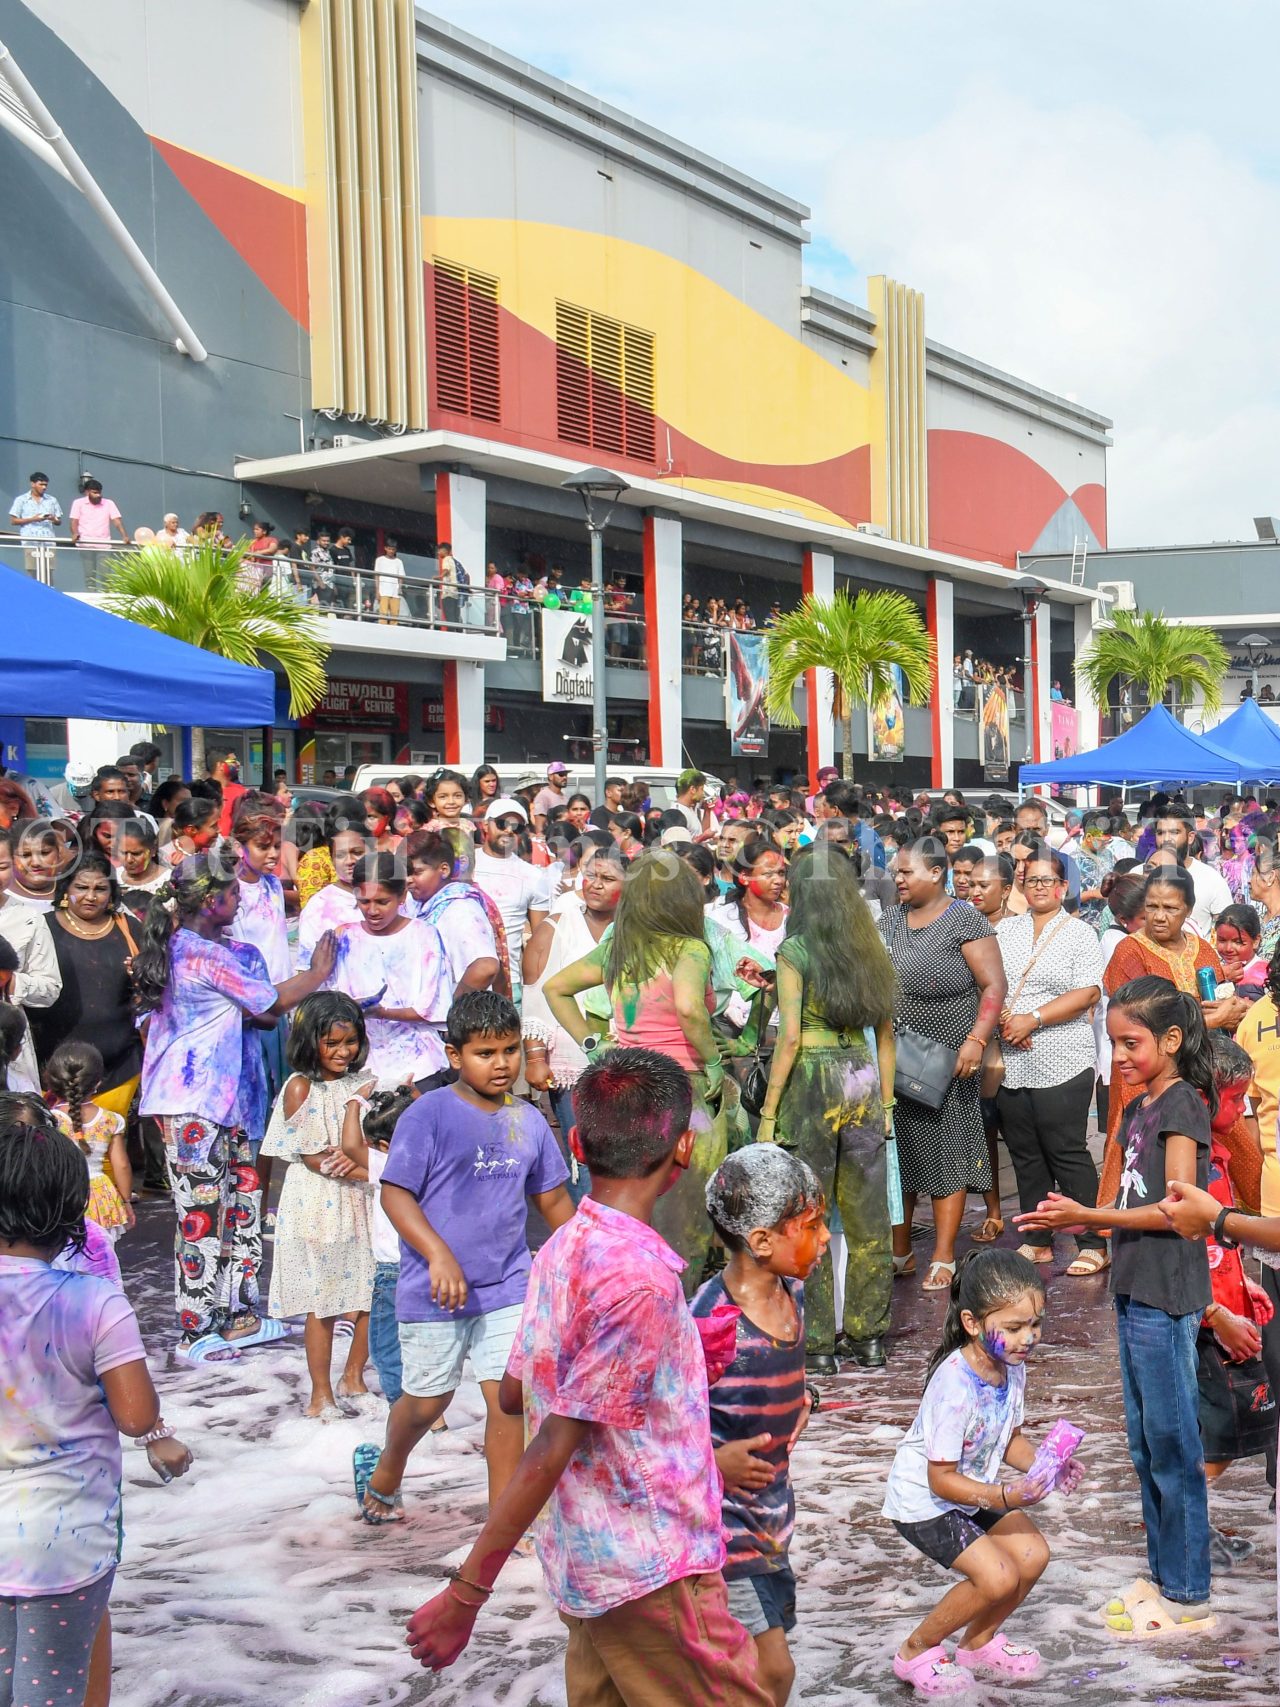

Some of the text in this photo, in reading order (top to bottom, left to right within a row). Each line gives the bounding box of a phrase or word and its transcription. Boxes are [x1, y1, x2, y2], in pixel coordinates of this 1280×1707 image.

[552, 671, 594, 702] Dogfath
[321, 697, 395, 714] FLIGHT CENTRE
[1257, 1016, 1280, 1042] H
